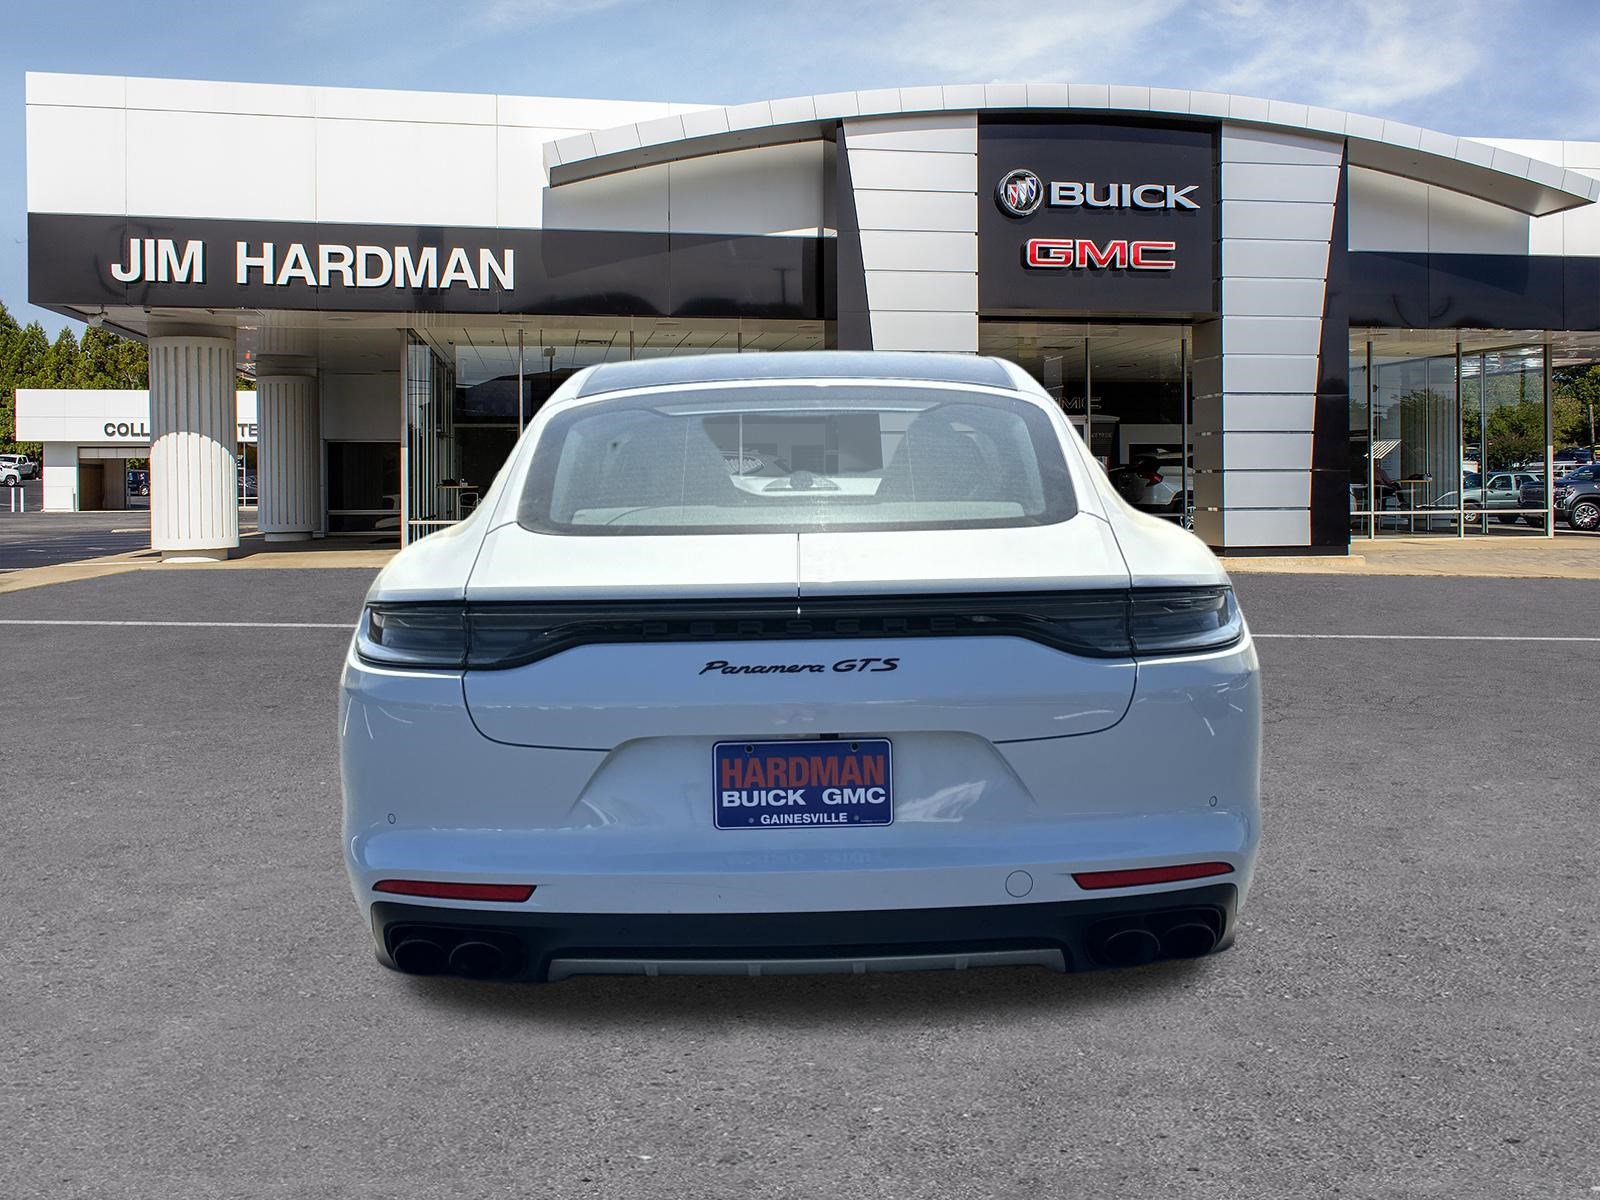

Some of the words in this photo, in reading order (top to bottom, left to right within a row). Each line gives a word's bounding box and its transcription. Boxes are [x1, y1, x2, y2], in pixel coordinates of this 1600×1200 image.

[1050, 181, 1200, 209] BUICK
[111, 238, 205, 284] JIM
[236, 241, 515, 290] HARDMAN
[1026, 238, 1176, 269] GMC
[104, 422, 150, 437] COLL
[699, 660, 825, 675] Panamera
[832, 658, 900, 673] GTS
[721, 755, 885, 789] HARDMAN
[722, 789, 806, 807] BUICK
[822, 787, 886, 805] GMC
[760, 813, 848, 824] GAINESVILLE
